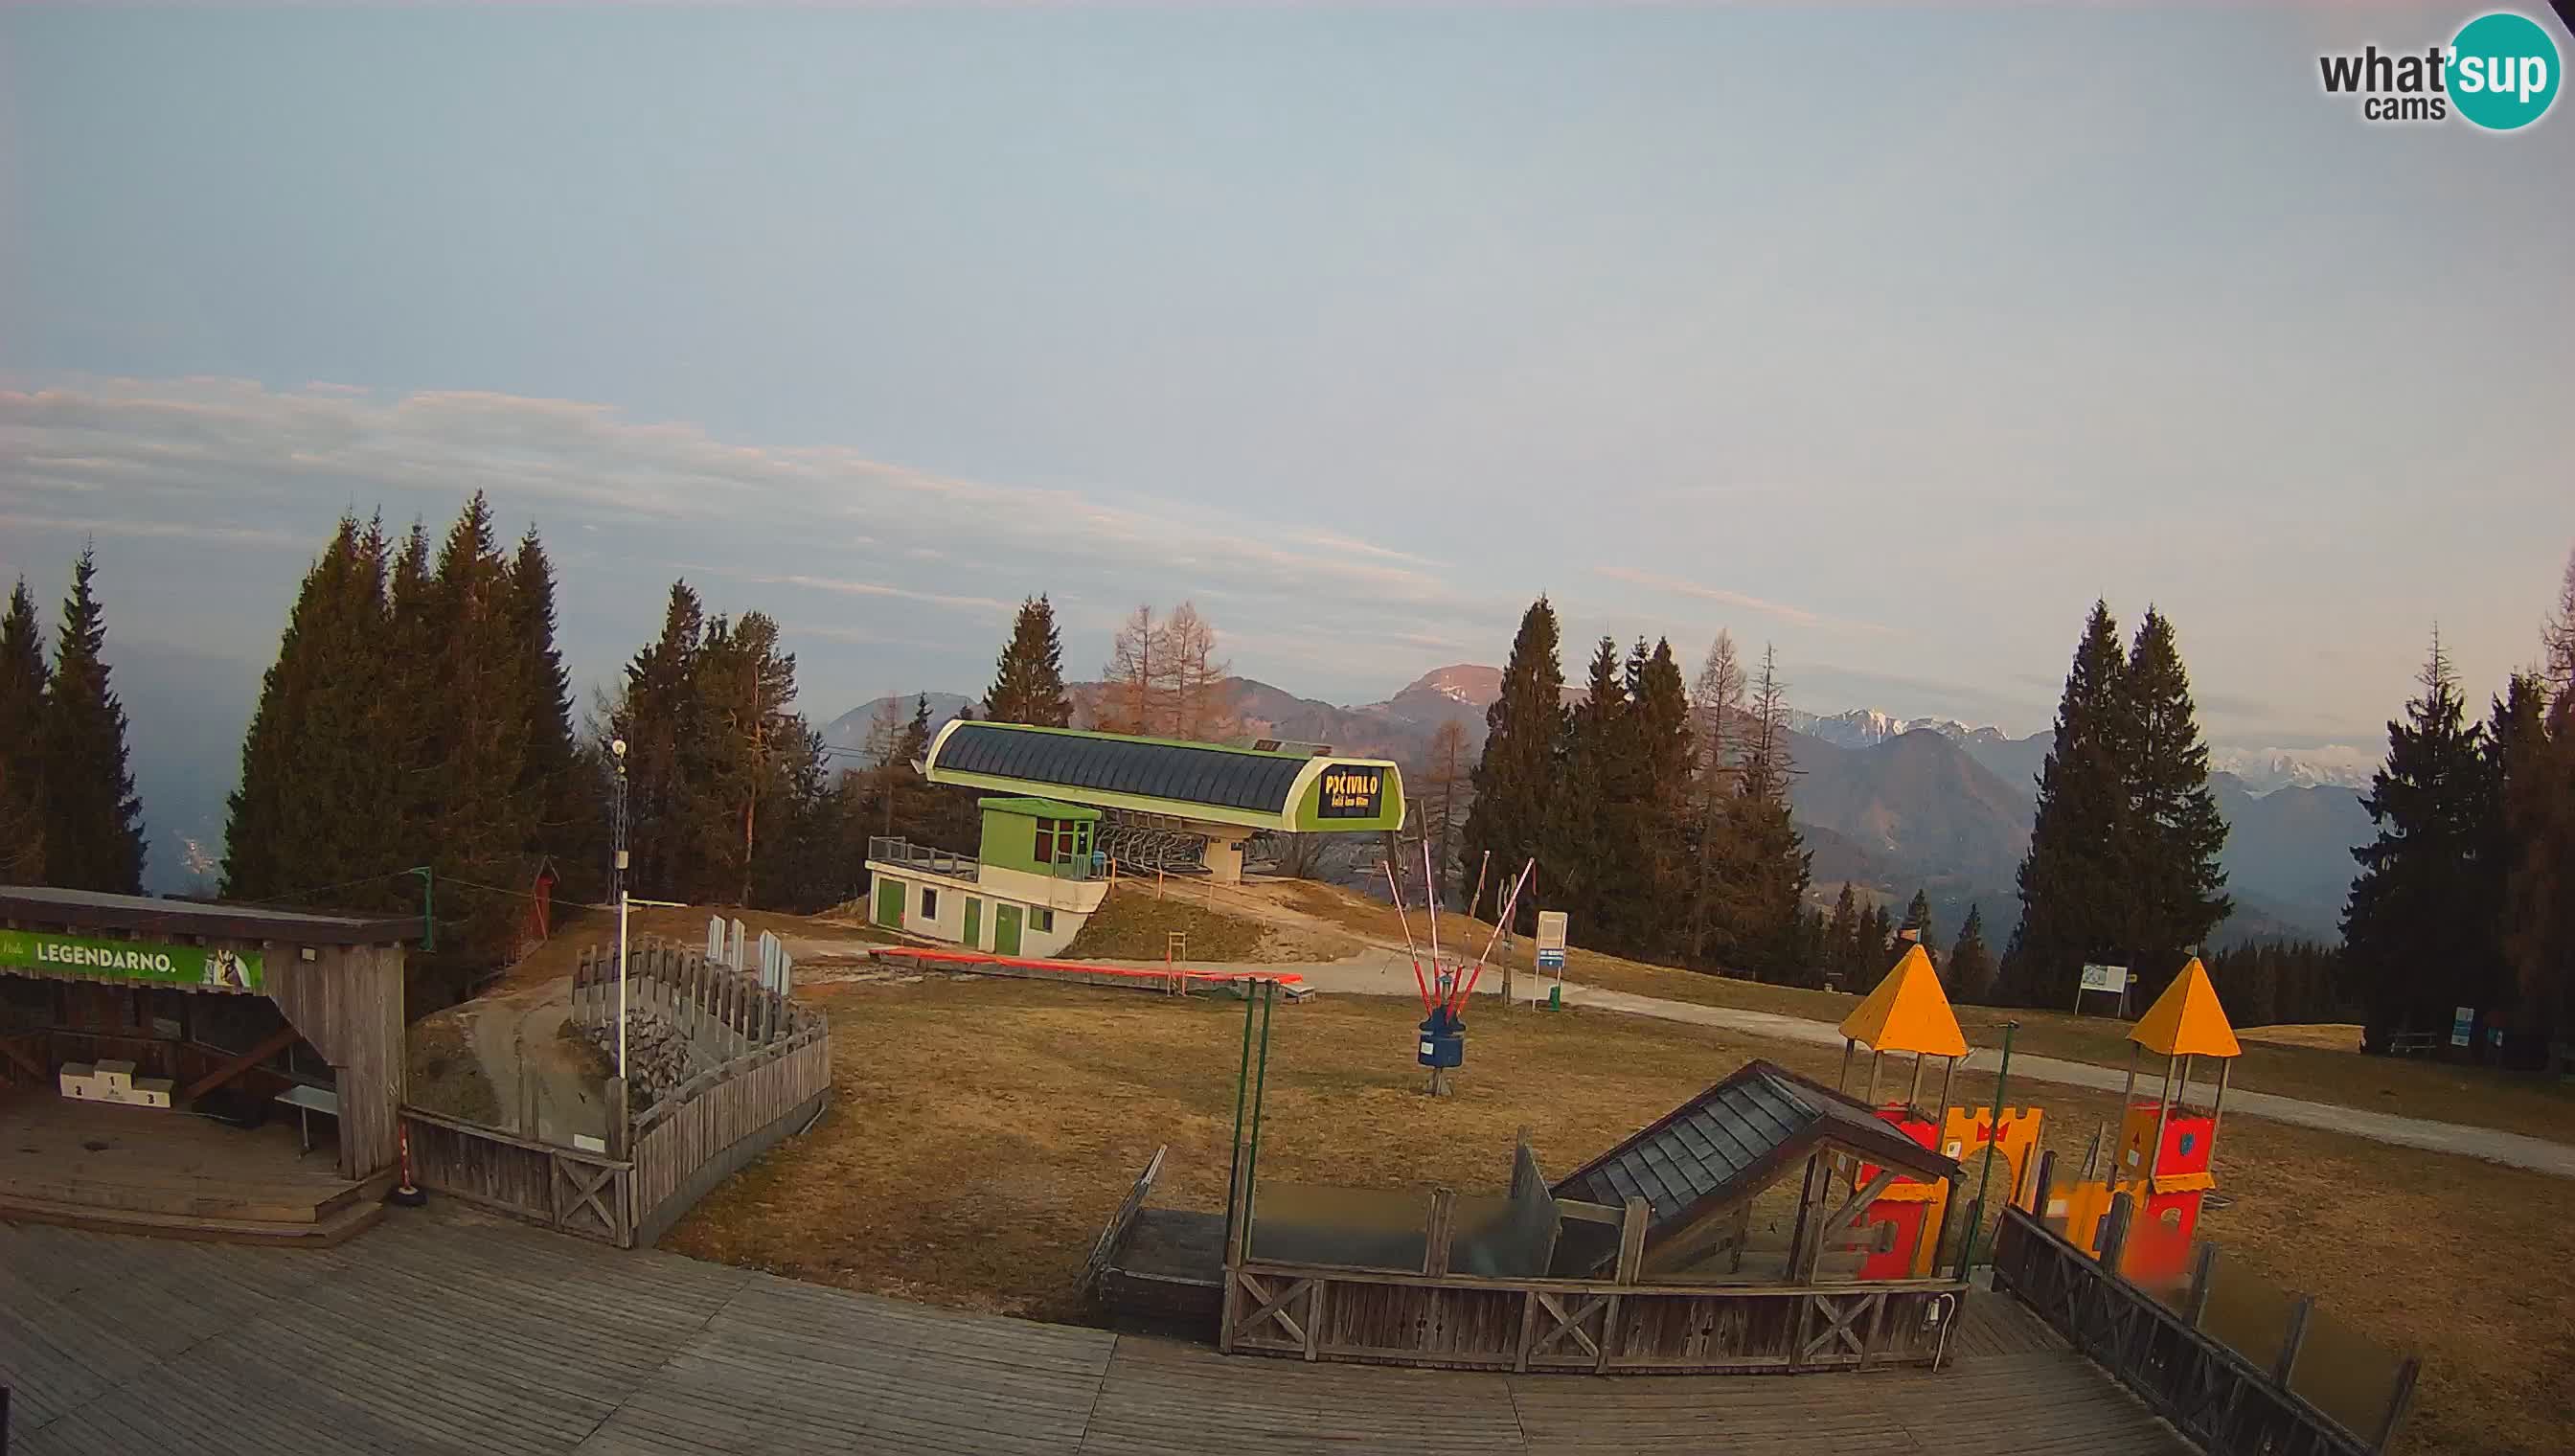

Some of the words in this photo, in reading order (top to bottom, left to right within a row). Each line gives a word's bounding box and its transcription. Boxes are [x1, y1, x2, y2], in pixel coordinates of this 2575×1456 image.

[36, 942, 177, 973] LEGENDARNO.
[109, 1076, 116, 1086] 1
[75, 1085, 83, 1096] 2
